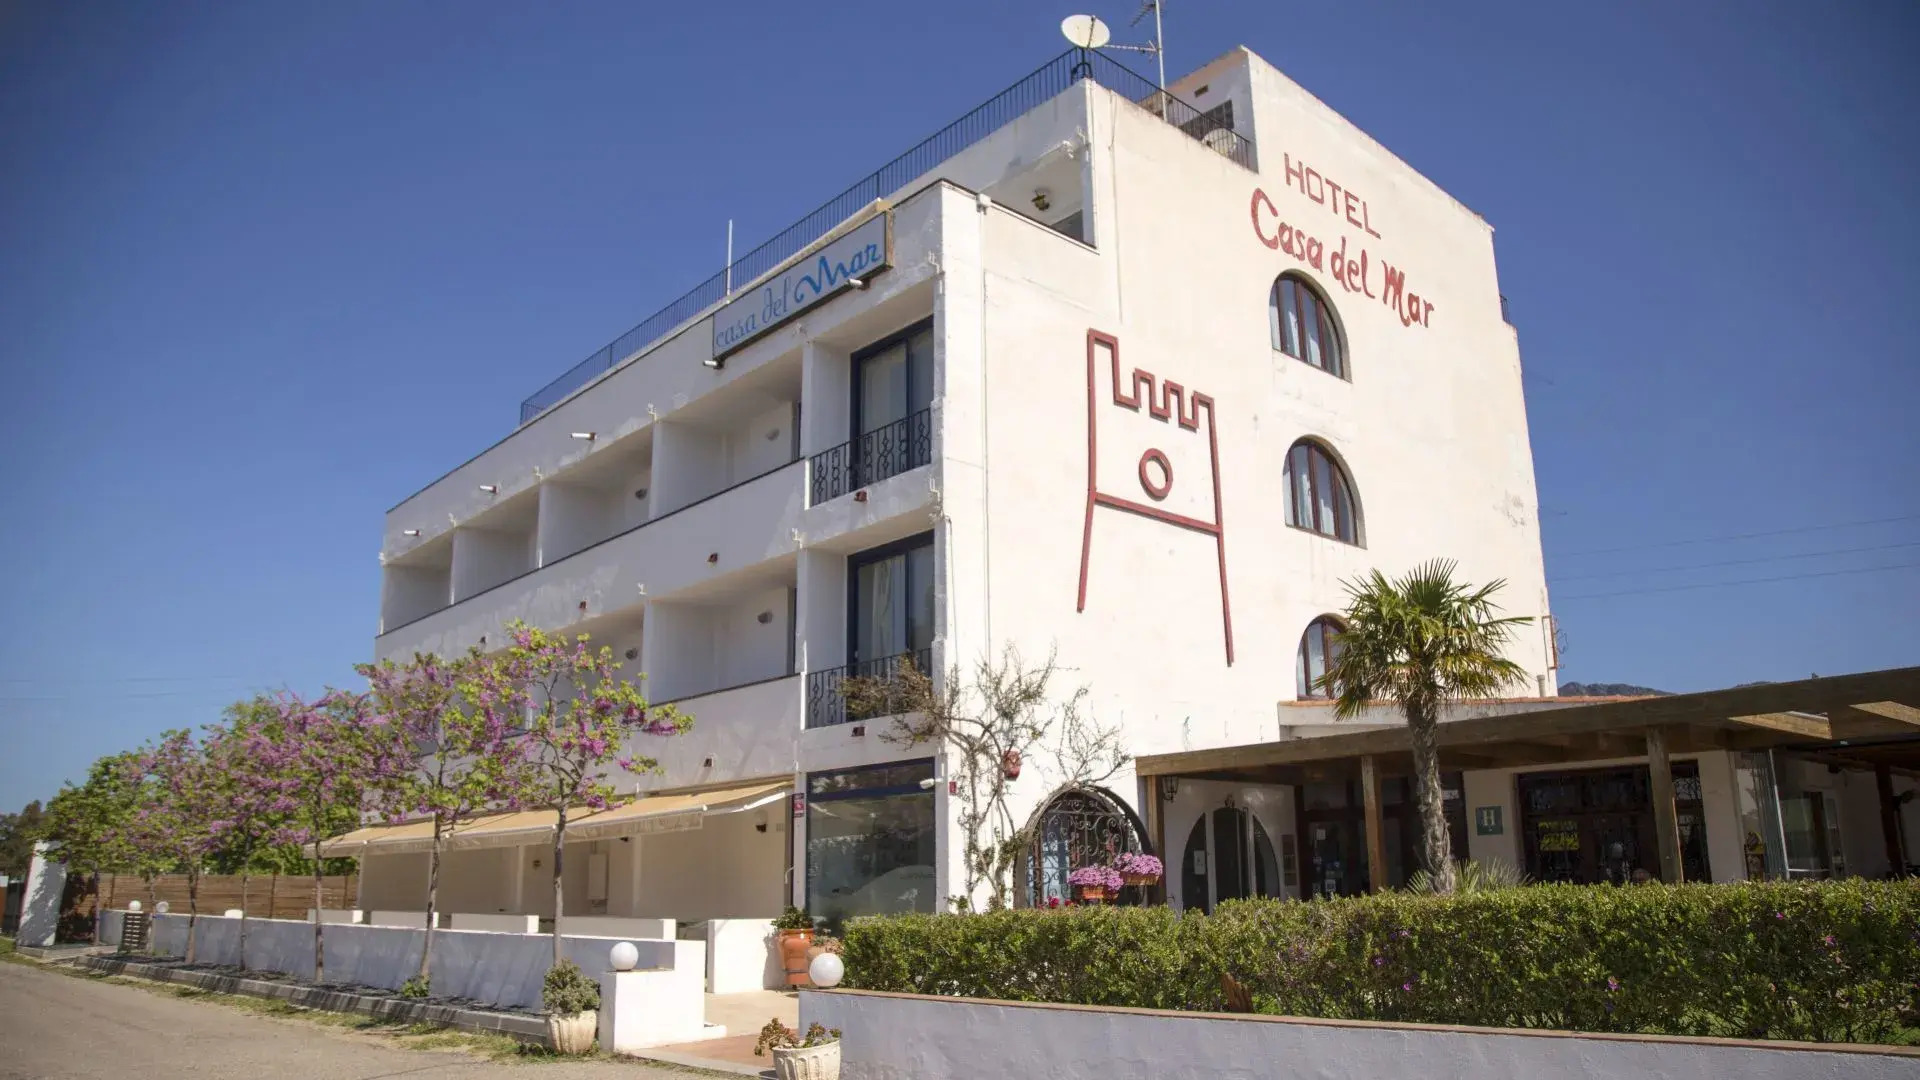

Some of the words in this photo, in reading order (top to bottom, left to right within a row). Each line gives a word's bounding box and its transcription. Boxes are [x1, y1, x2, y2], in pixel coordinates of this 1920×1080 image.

[1284, 152, 1381, 240] HOTEL
[715, 312, 757, 348] casa
[761, 276, 795, 324] del
[794, 243, 882, 304] Mar
[1250, 187, 1324, 274] Casa
[1330, 236, 1375, 299] del
[1381, 259, 1434, 328] Mar
